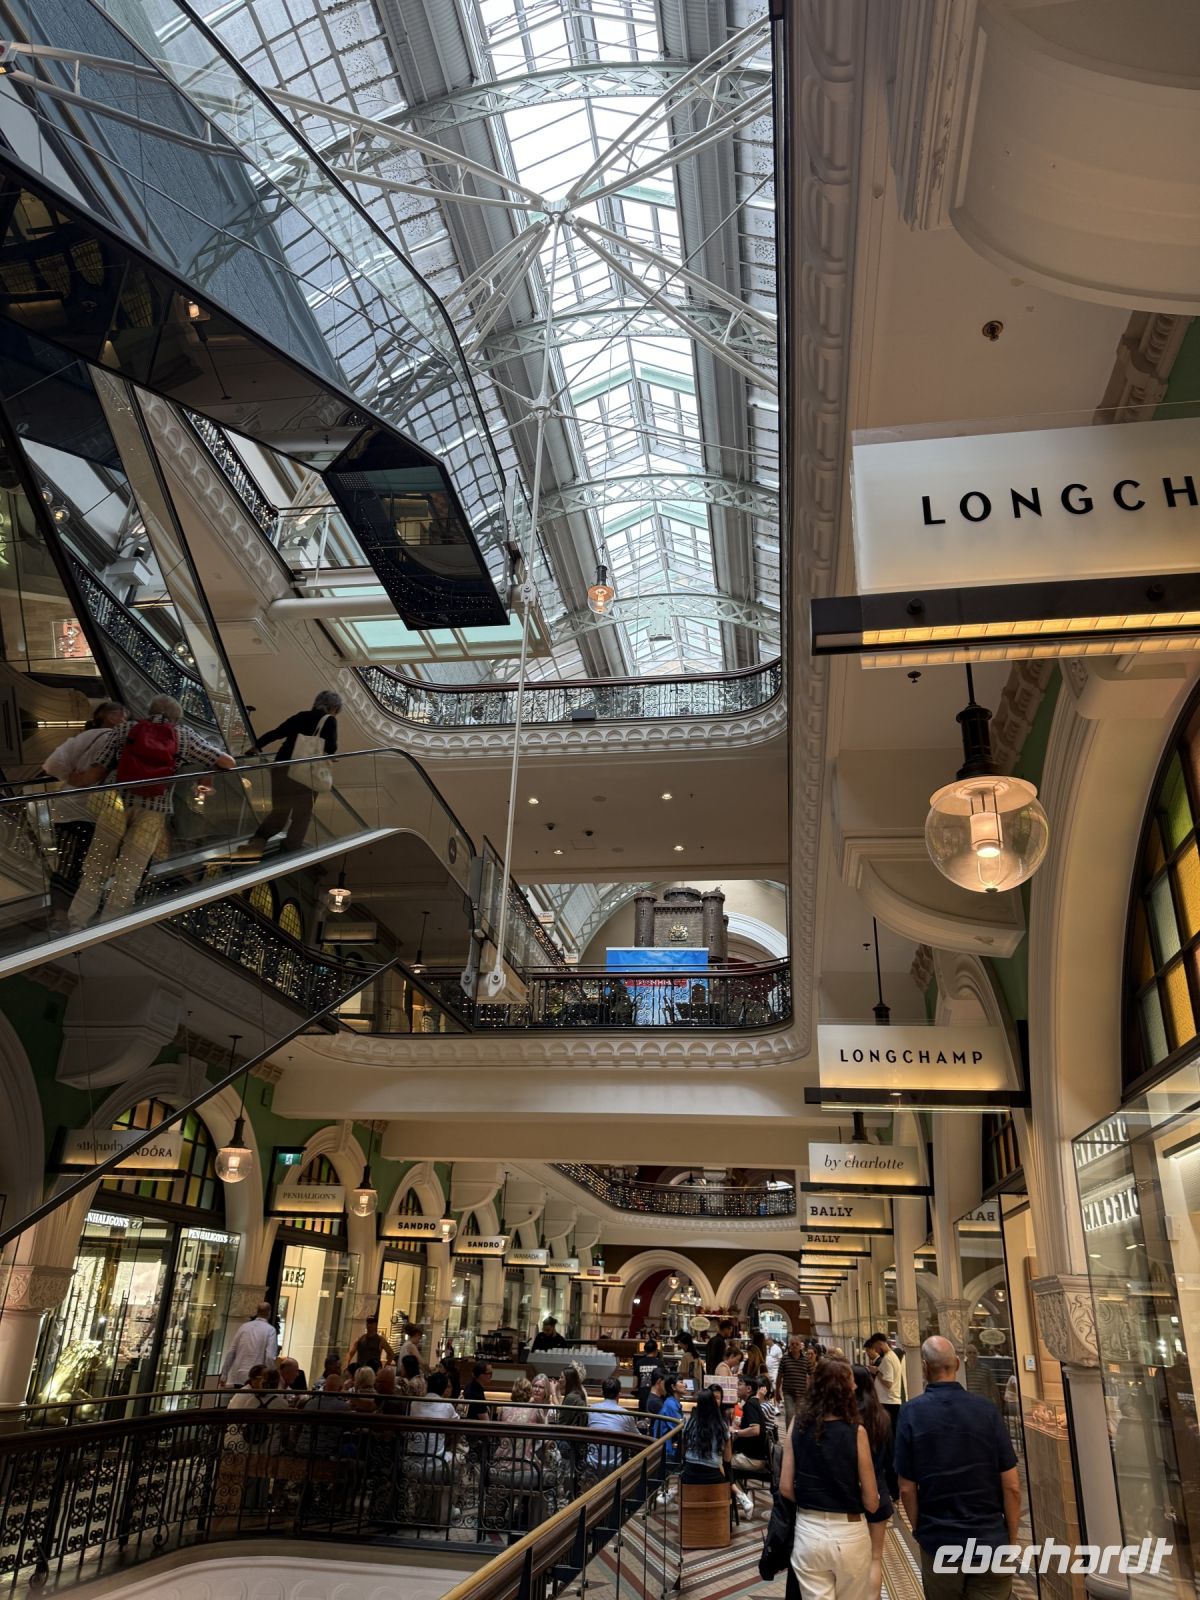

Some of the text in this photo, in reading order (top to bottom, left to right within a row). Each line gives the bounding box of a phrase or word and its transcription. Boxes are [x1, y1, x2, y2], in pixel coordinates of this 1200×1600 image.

[921, 475, 1200, 525] LONGCH
[839, 1048, 984, 1065] LONGCHAMP
[824, 1155, 904, 1171] by charlotte
[810, 1206, 853, 1217] BALLY
[398, 1222, 436, 1230] SANDRO
[806, 1234, 840, 1243] BALLY
